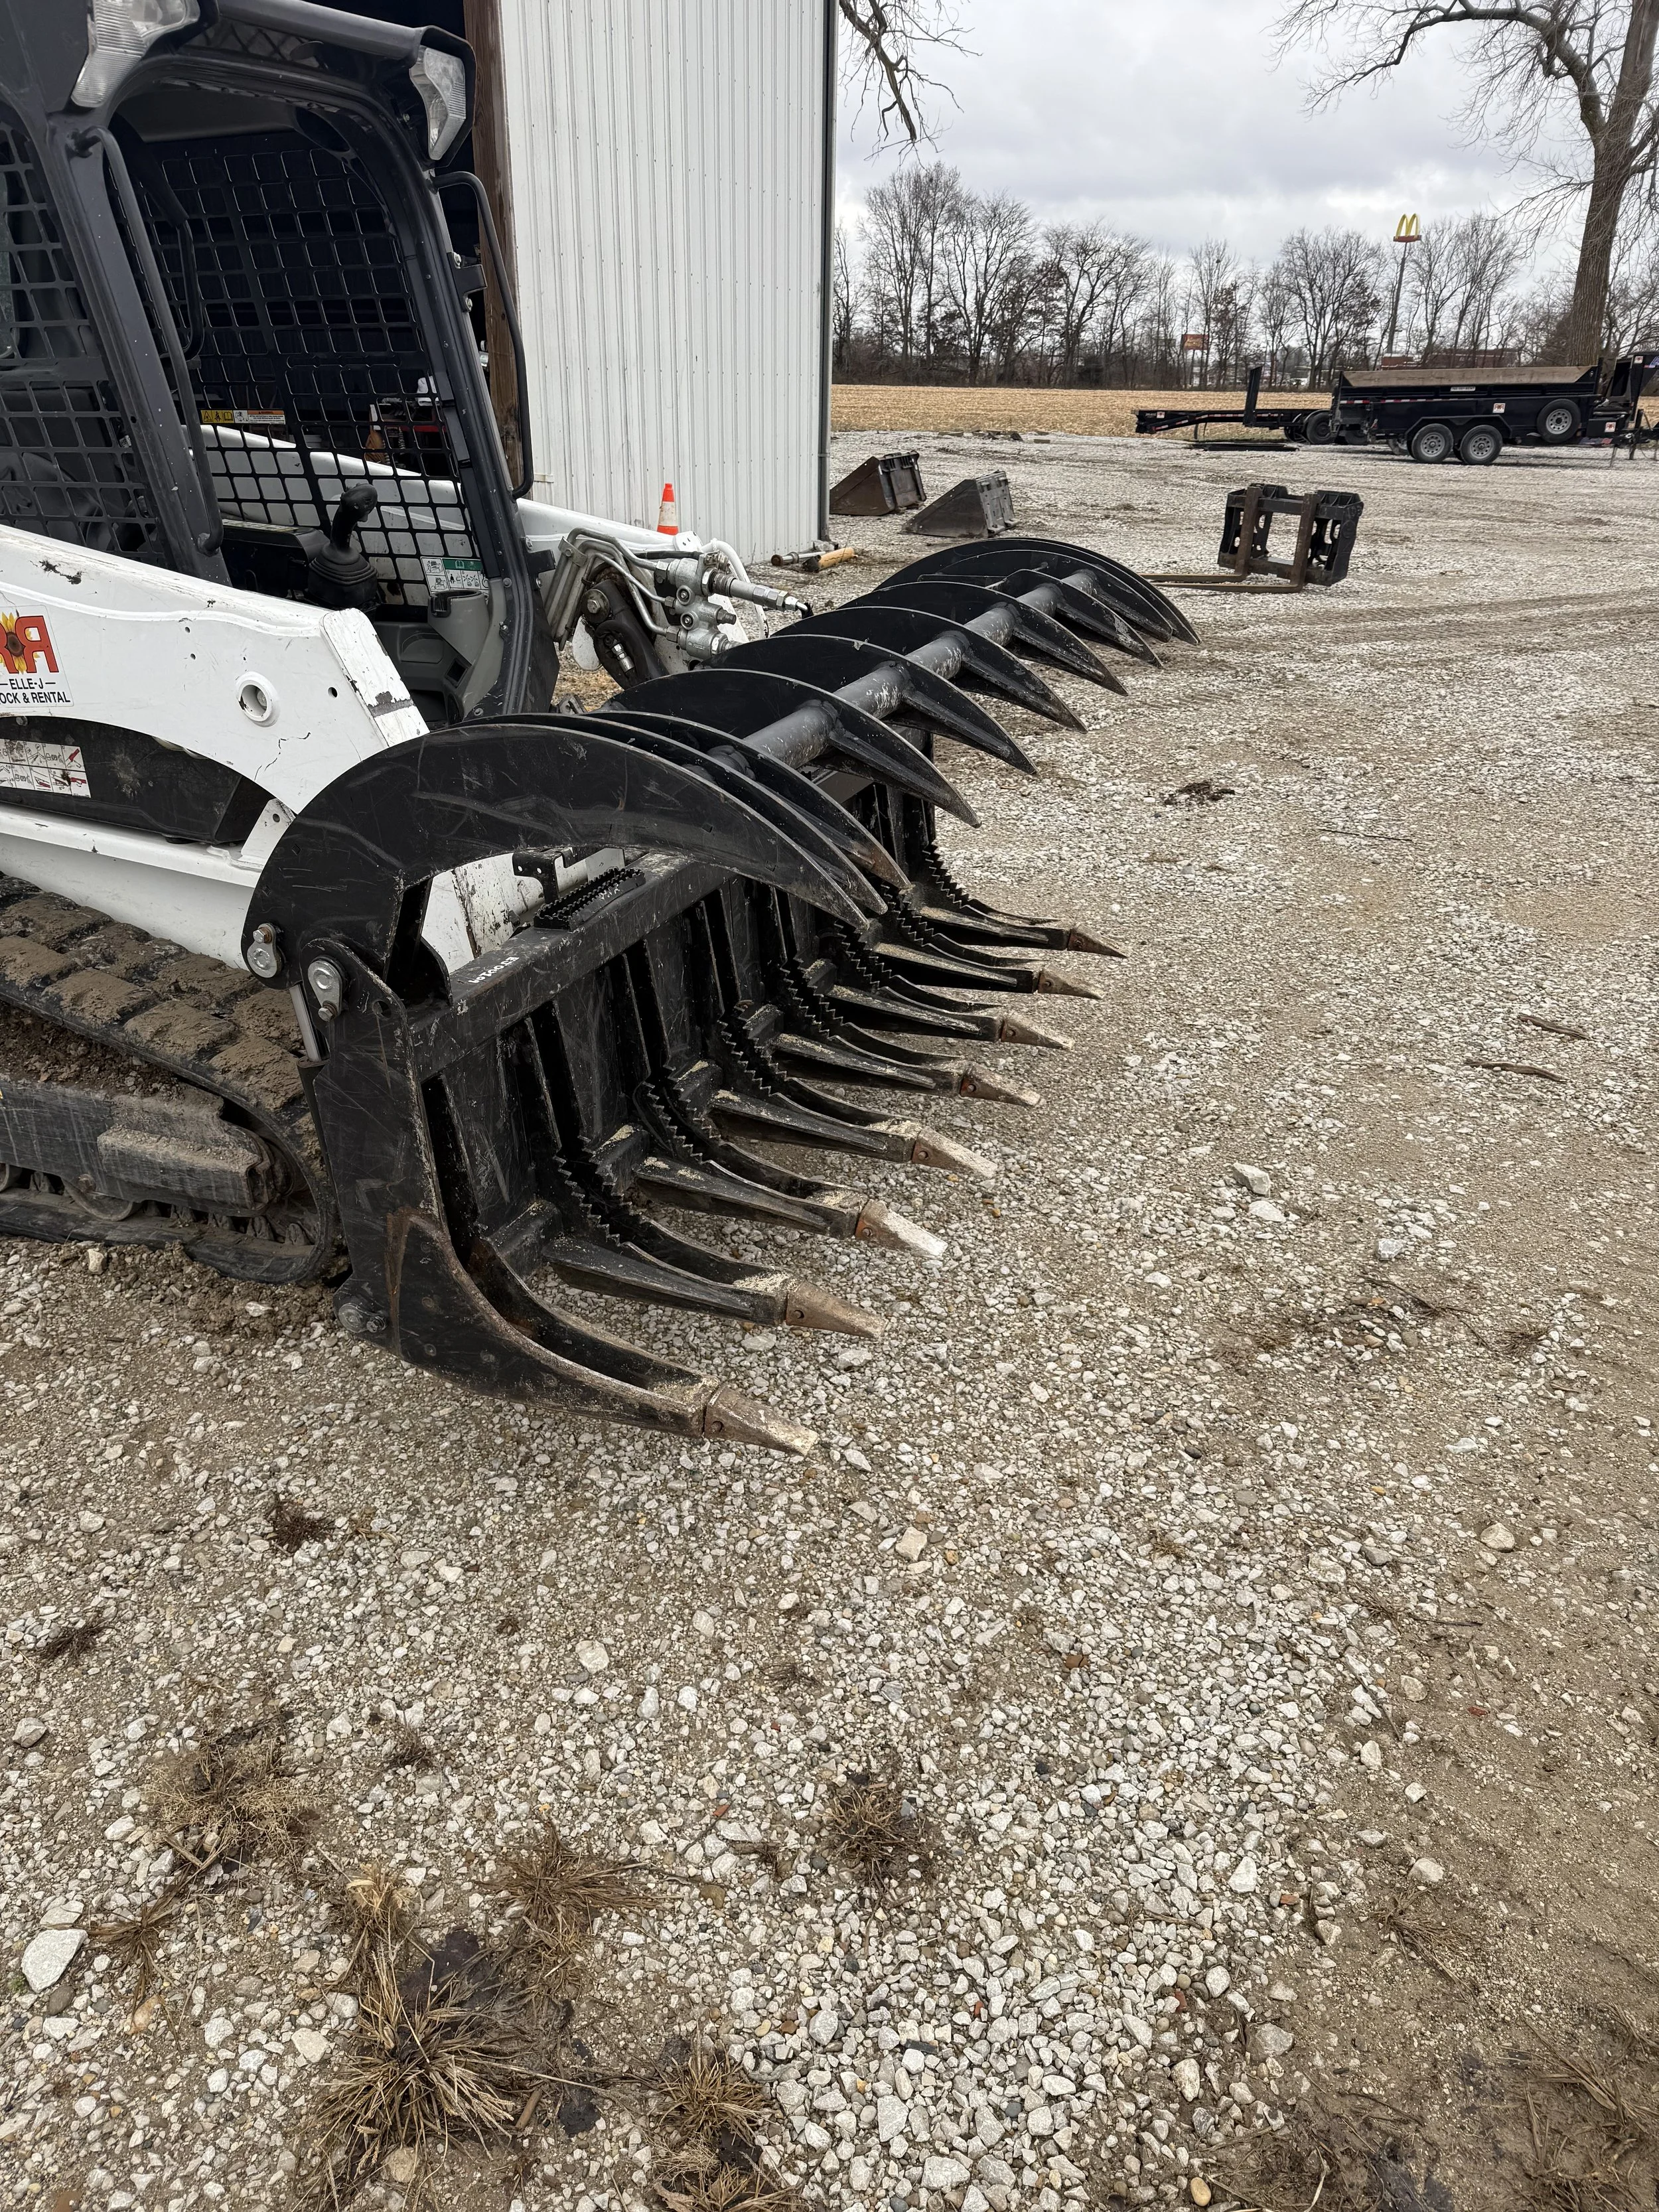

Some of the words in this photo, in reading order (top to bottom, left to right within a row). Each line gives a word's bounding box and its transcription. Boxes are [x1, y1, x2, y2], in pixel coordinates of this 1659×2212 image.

[0, 692, 21, 704] OCK
[23, 692, 30, 703] &
[31, 692, 70, 703] RENTAL
